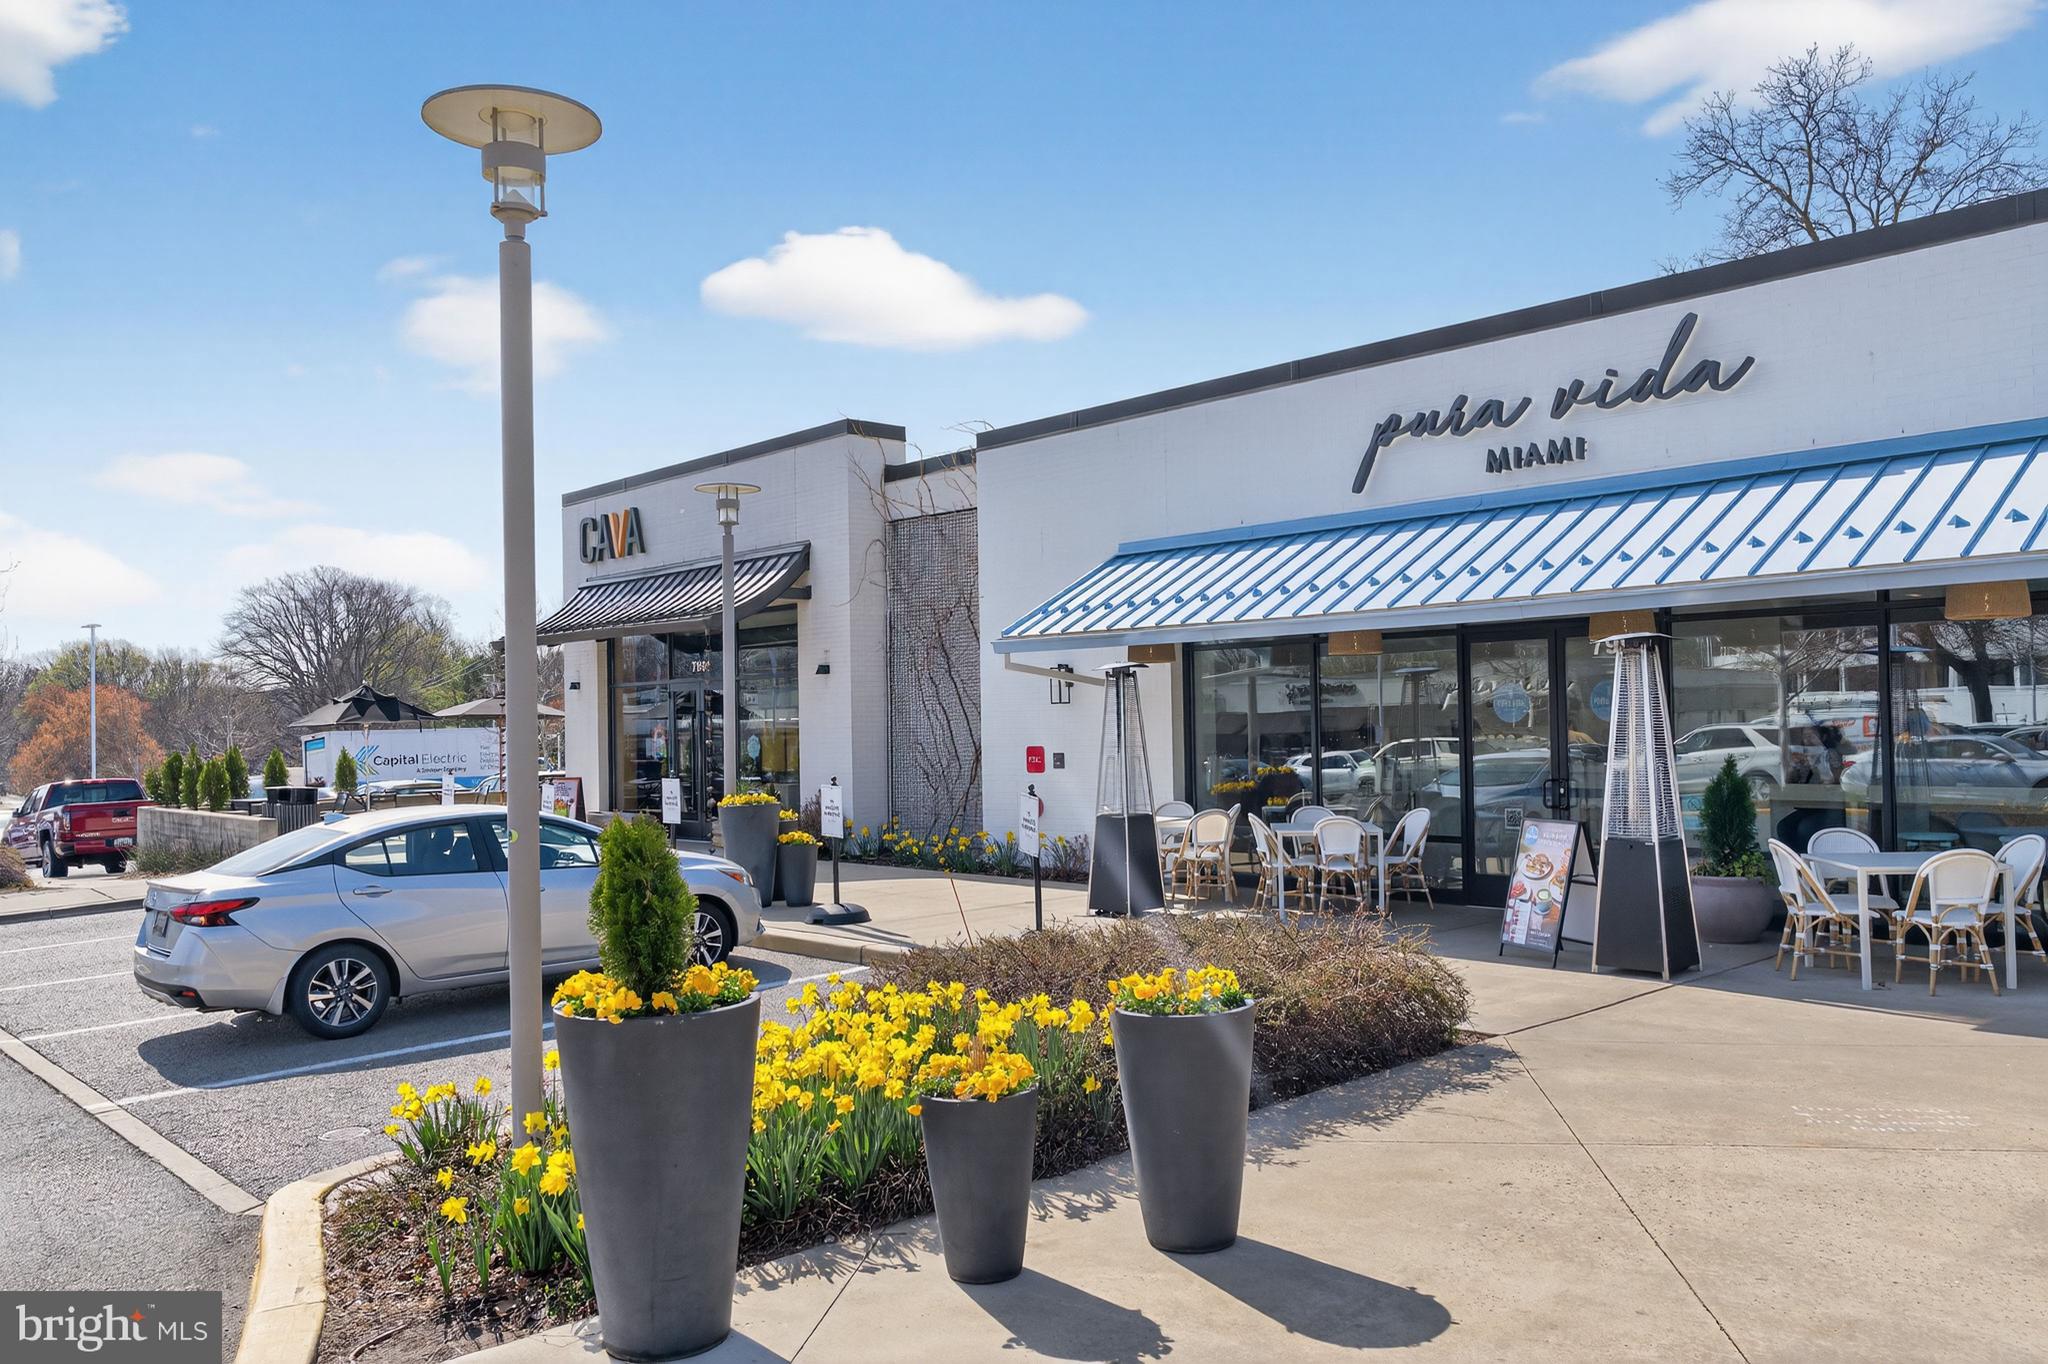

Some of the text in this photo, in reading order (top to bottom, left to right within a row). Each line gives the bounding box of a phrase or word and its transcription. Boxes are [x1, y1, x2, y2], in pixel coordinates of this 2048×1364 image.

[1352, 312, 1756, 494] pura vida
[1485, 437, 1588, 474] MIAMI
[580, 506, 646, 564] CAVA
[373, 754, 419, 768] Capital
[421, 751, 468, 765] Electric
